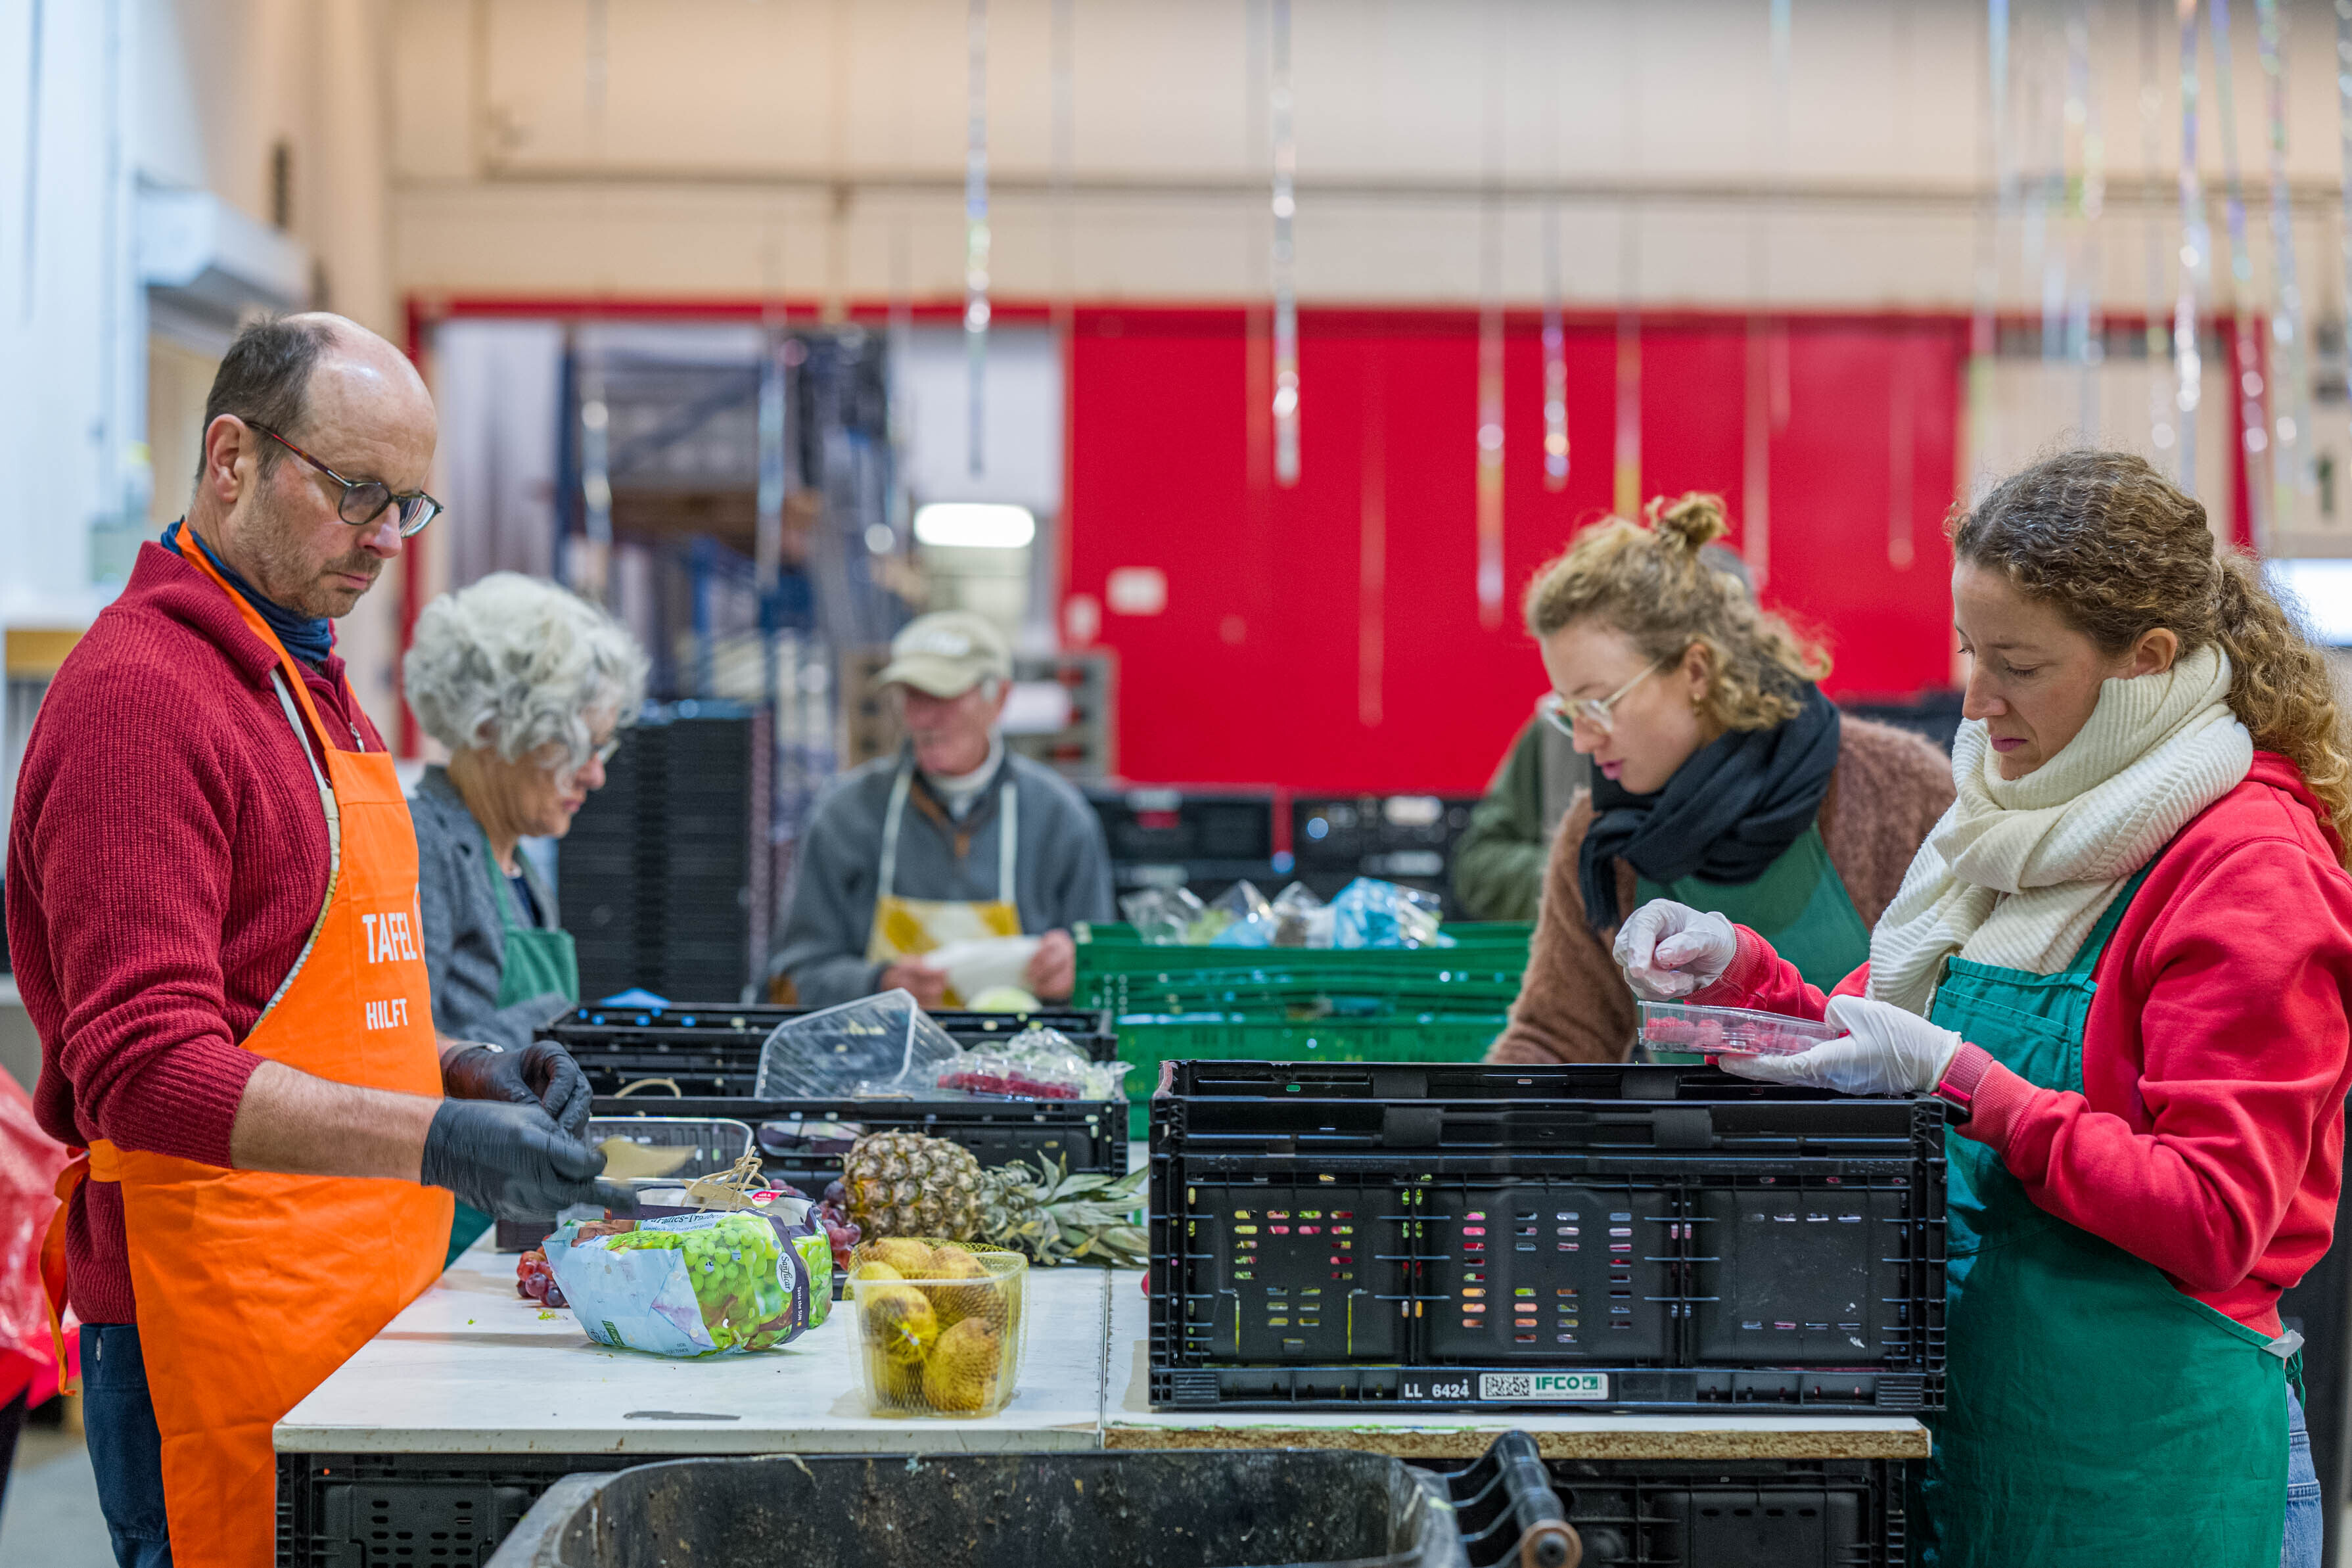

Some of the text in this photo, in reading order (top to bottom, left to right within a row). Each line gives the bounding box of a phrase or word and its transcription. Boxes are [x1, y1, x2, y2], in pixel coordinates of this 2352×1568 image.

[362, 912, 418, 963] TAFEL
[366, 998, 408, 1030] HILFT
[779, 1256, 793, 1290] SanLucar
[1404, 1383, 1469, 1398] LL 6424
[1536, 1377, 1580, 1390] IFCO
